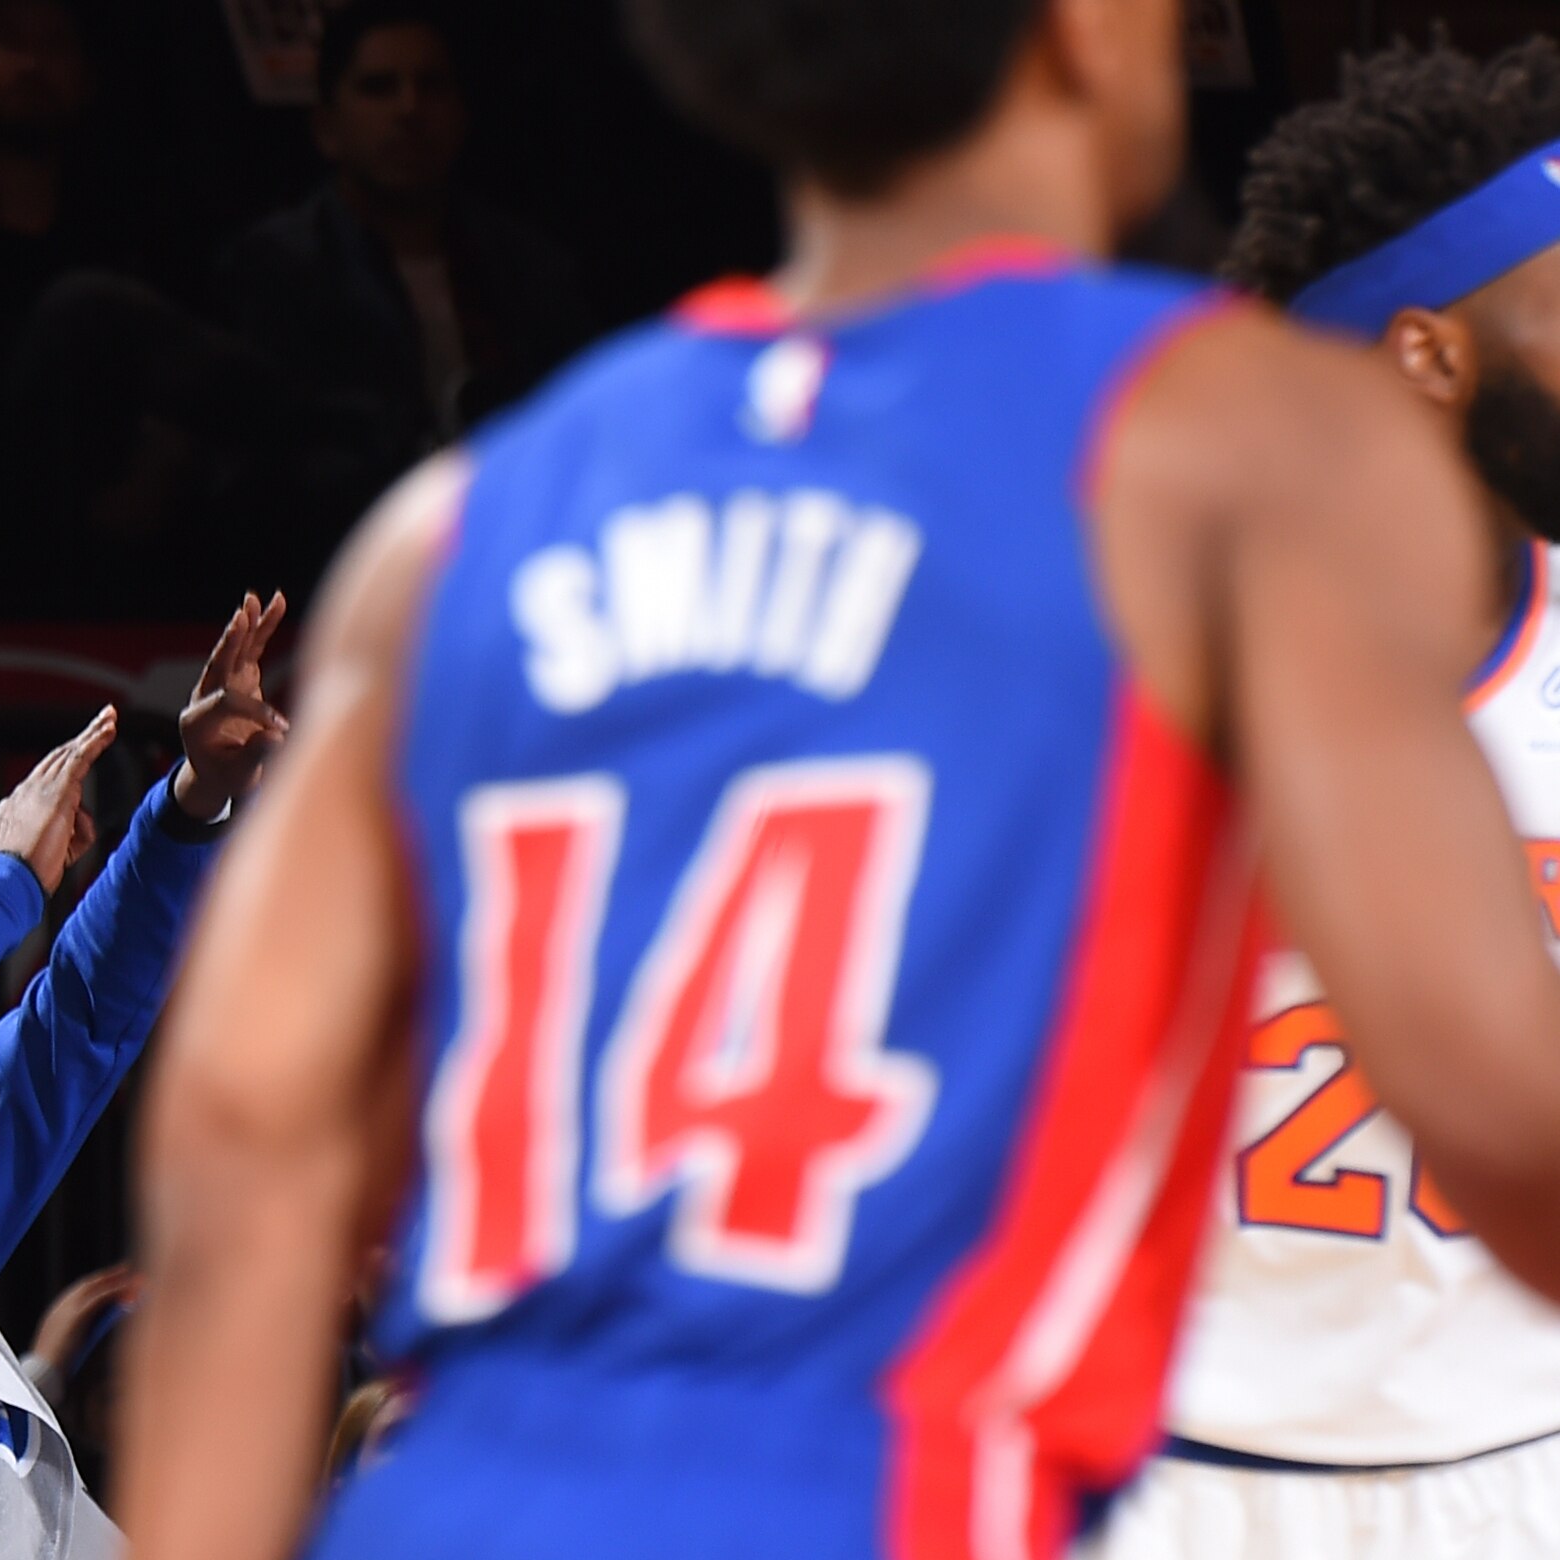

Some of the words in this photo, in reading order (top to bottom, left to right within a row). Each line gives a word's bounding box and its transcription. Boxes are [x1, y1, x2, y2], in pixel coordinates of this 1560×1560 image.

[510, 488, 922, 716] SMITH
[418, 750, 938, 1325] 14
[1238, 998, 1472, 1240] 2
